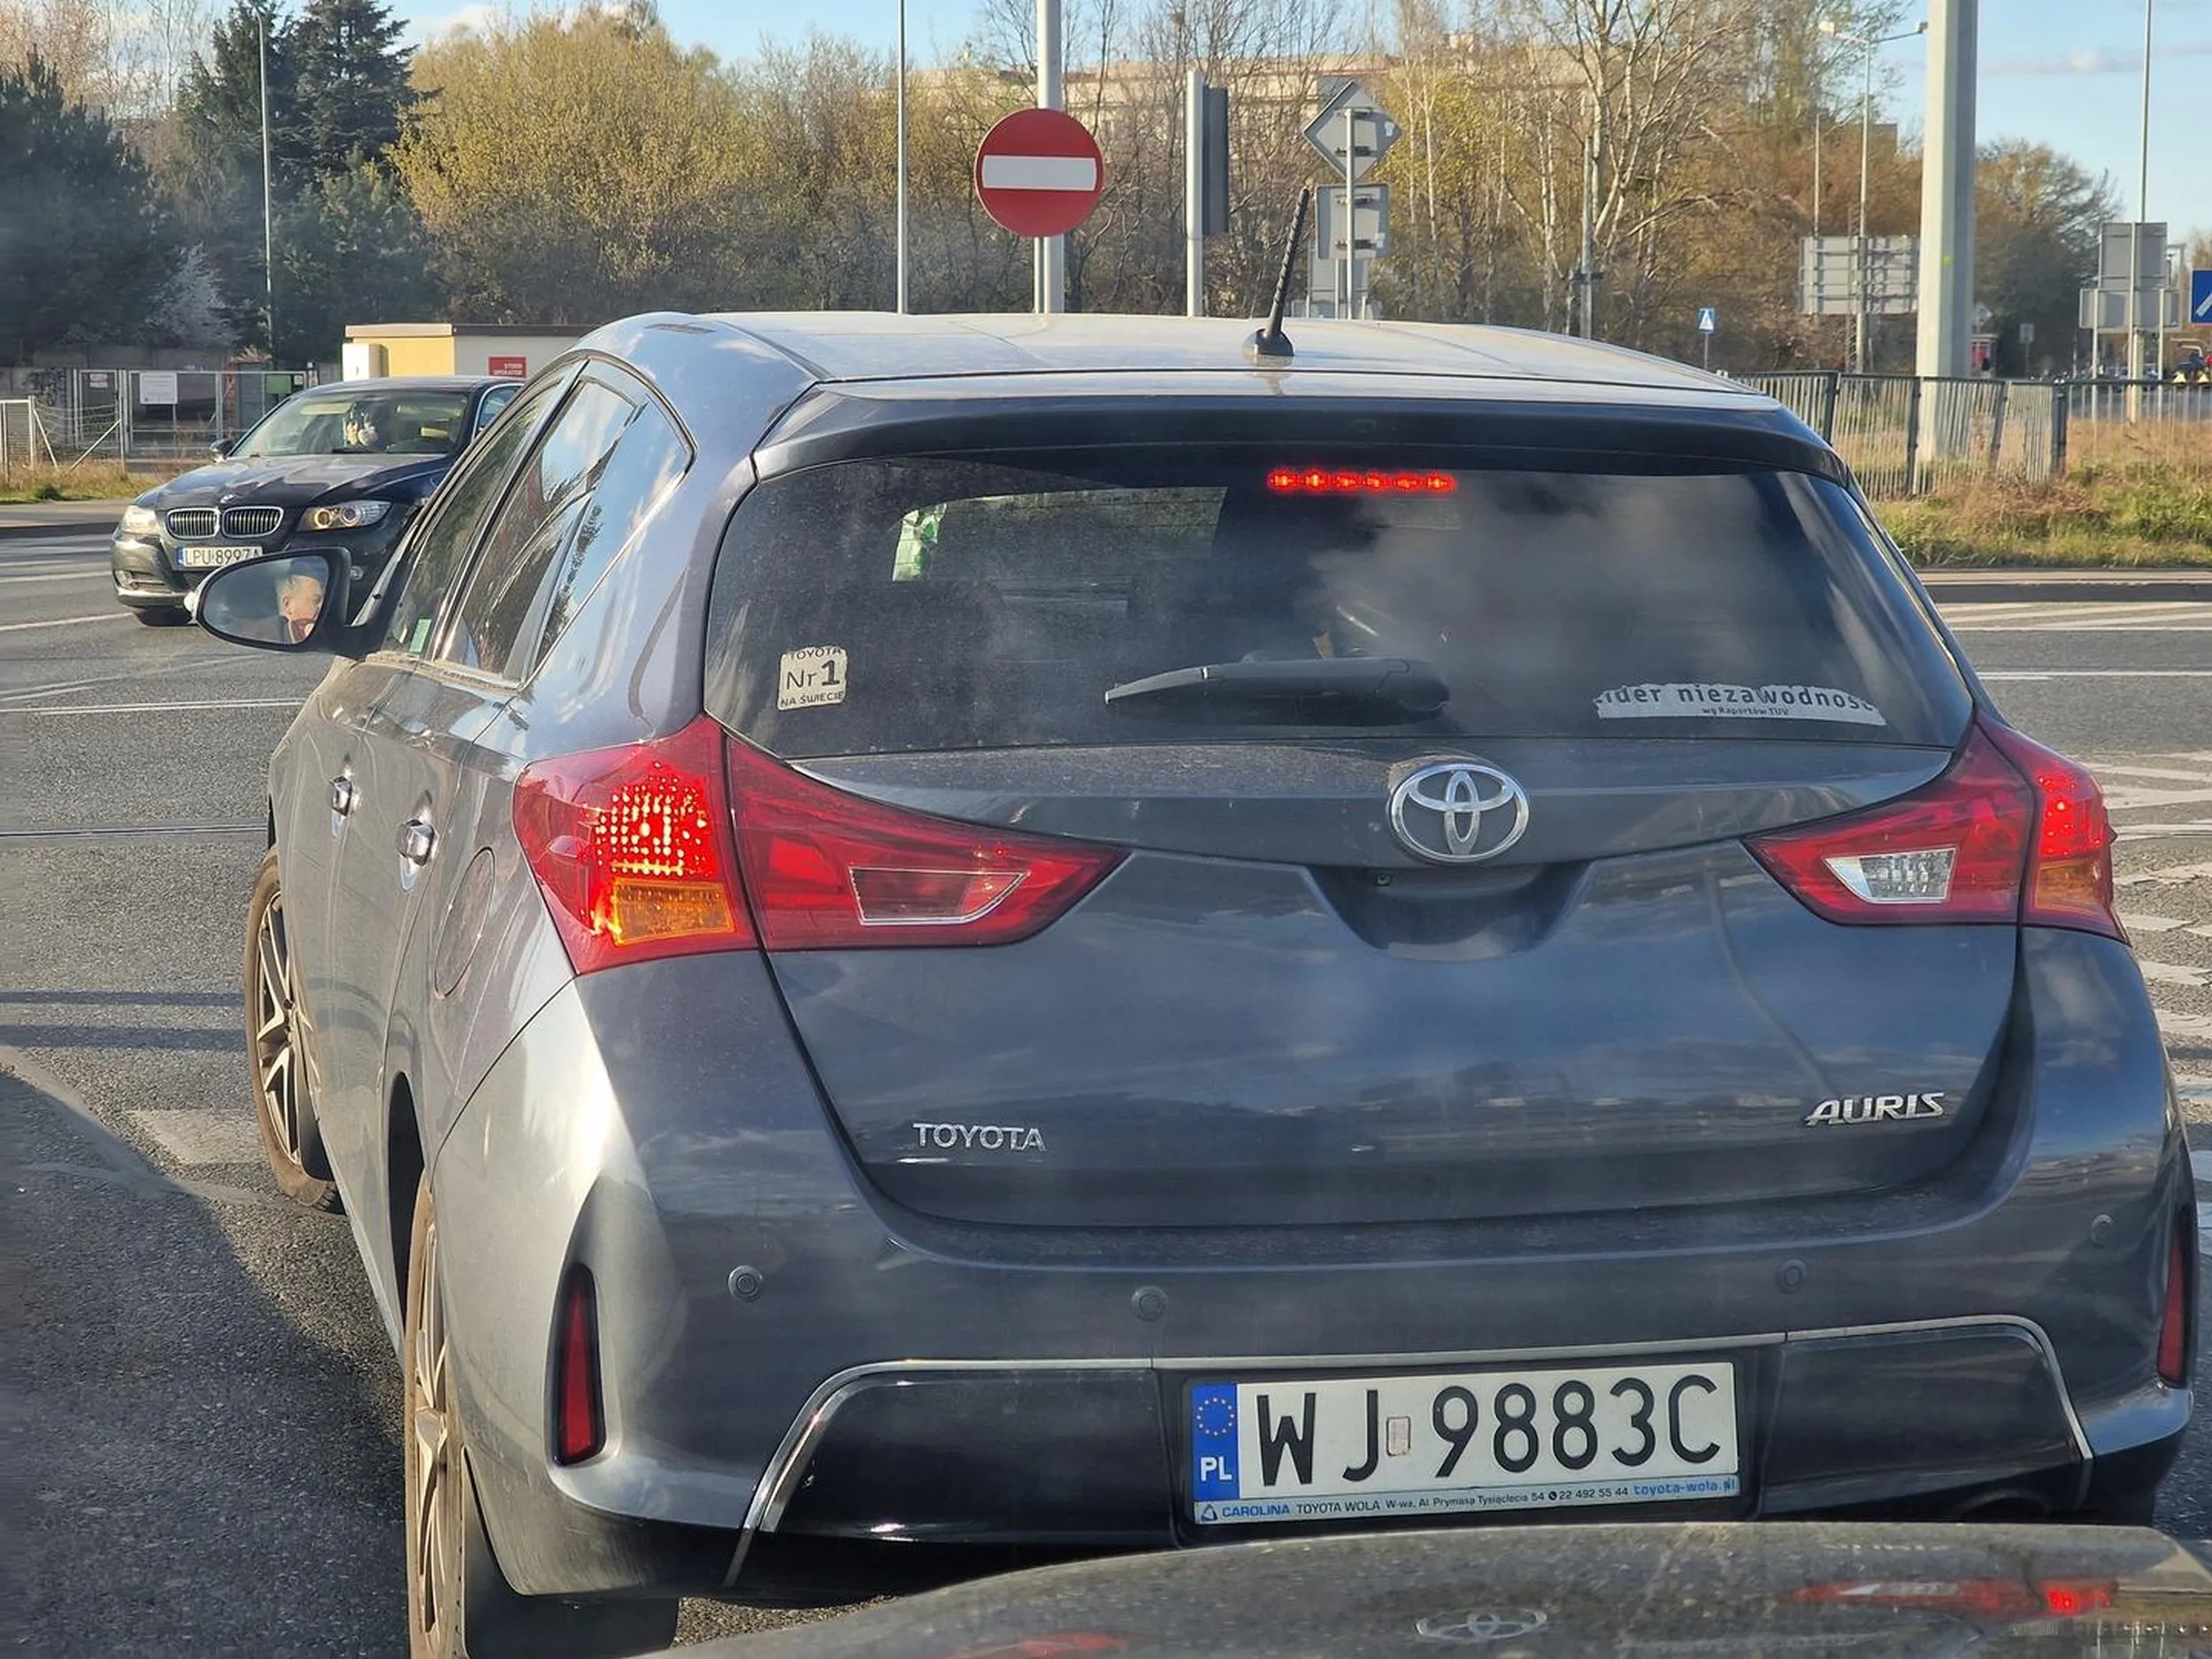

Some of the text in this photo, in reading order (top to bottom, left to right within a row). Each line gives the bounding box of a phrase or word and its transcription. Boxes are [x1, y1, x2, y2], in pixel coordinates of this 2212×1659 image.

[185, 549, 212, 565] LPU
[787, 647, 842, 661] TOYOTA
[787, 659, 841, 690] Nr 1
[781, 697, 796, 706] NA
[1678, 684, 1873, 711] niezawodnos
[1804, 1092, 1945, 1127] AURIS
[912, 1122, 1046, 1152] TOYOTA
[1256, 1374, 1721, 1487] WJ 9883C
[1200, 1456, 1233, 1482] PL
[1222, 1504, 1291, 1517] CAROLINA
[1296, 1502, 1341, 1515] TOYOTA
[1345, 1499, 1381, 1512] WOLA
[1432, 1495, 1476, 1508] Prymasa
[1531, 1491, 1546, 1502] 54
[1559, 1490, 1573, 1501] 22
[1575, 1488, 1596, 1499] 492
[1598, 1487, 1612, 1498] 55
[1614, 1486, 1629, 1496] 44
[1633, 1476, 1736, 1496] toyota-wola.pl
